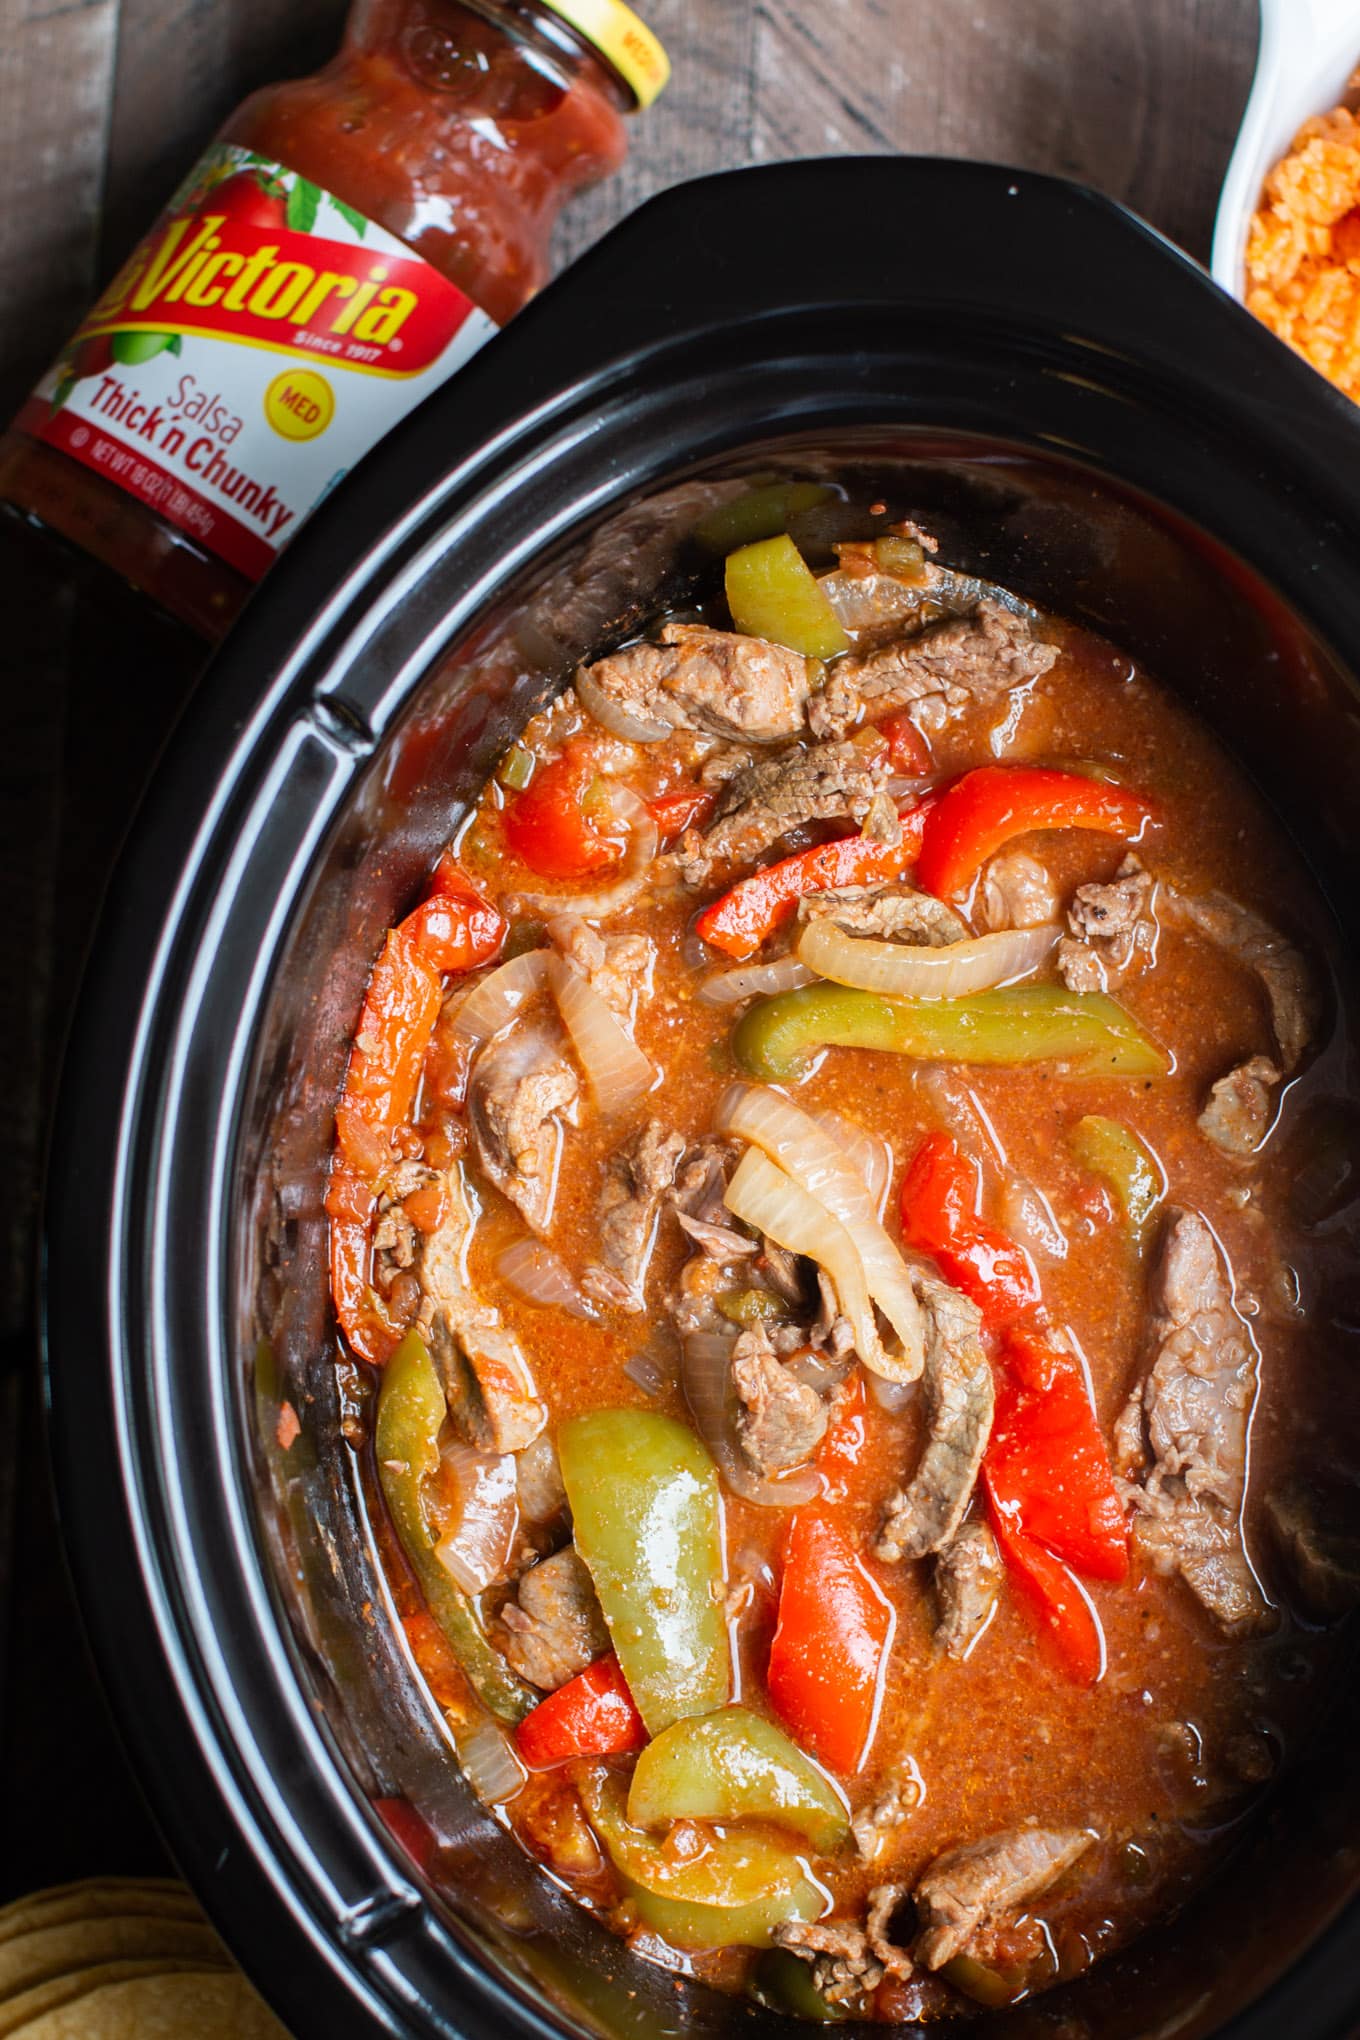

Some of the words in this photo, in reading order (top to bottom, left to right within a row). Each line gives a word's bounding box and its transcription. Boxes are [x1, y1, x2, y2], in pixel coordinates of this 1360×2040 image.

[130, 215, 419, 346] Victoria
[293, 330, 342, 353] Since
[346, 343, 383, 363] 1917
[167, 374, 244, 445] Salsa
[279, 385, 322, 425] MED
[89, 438, 118, 463] NET
[109, 452, 137, 476] WT
[184, 437, 296, 538] Chunky
